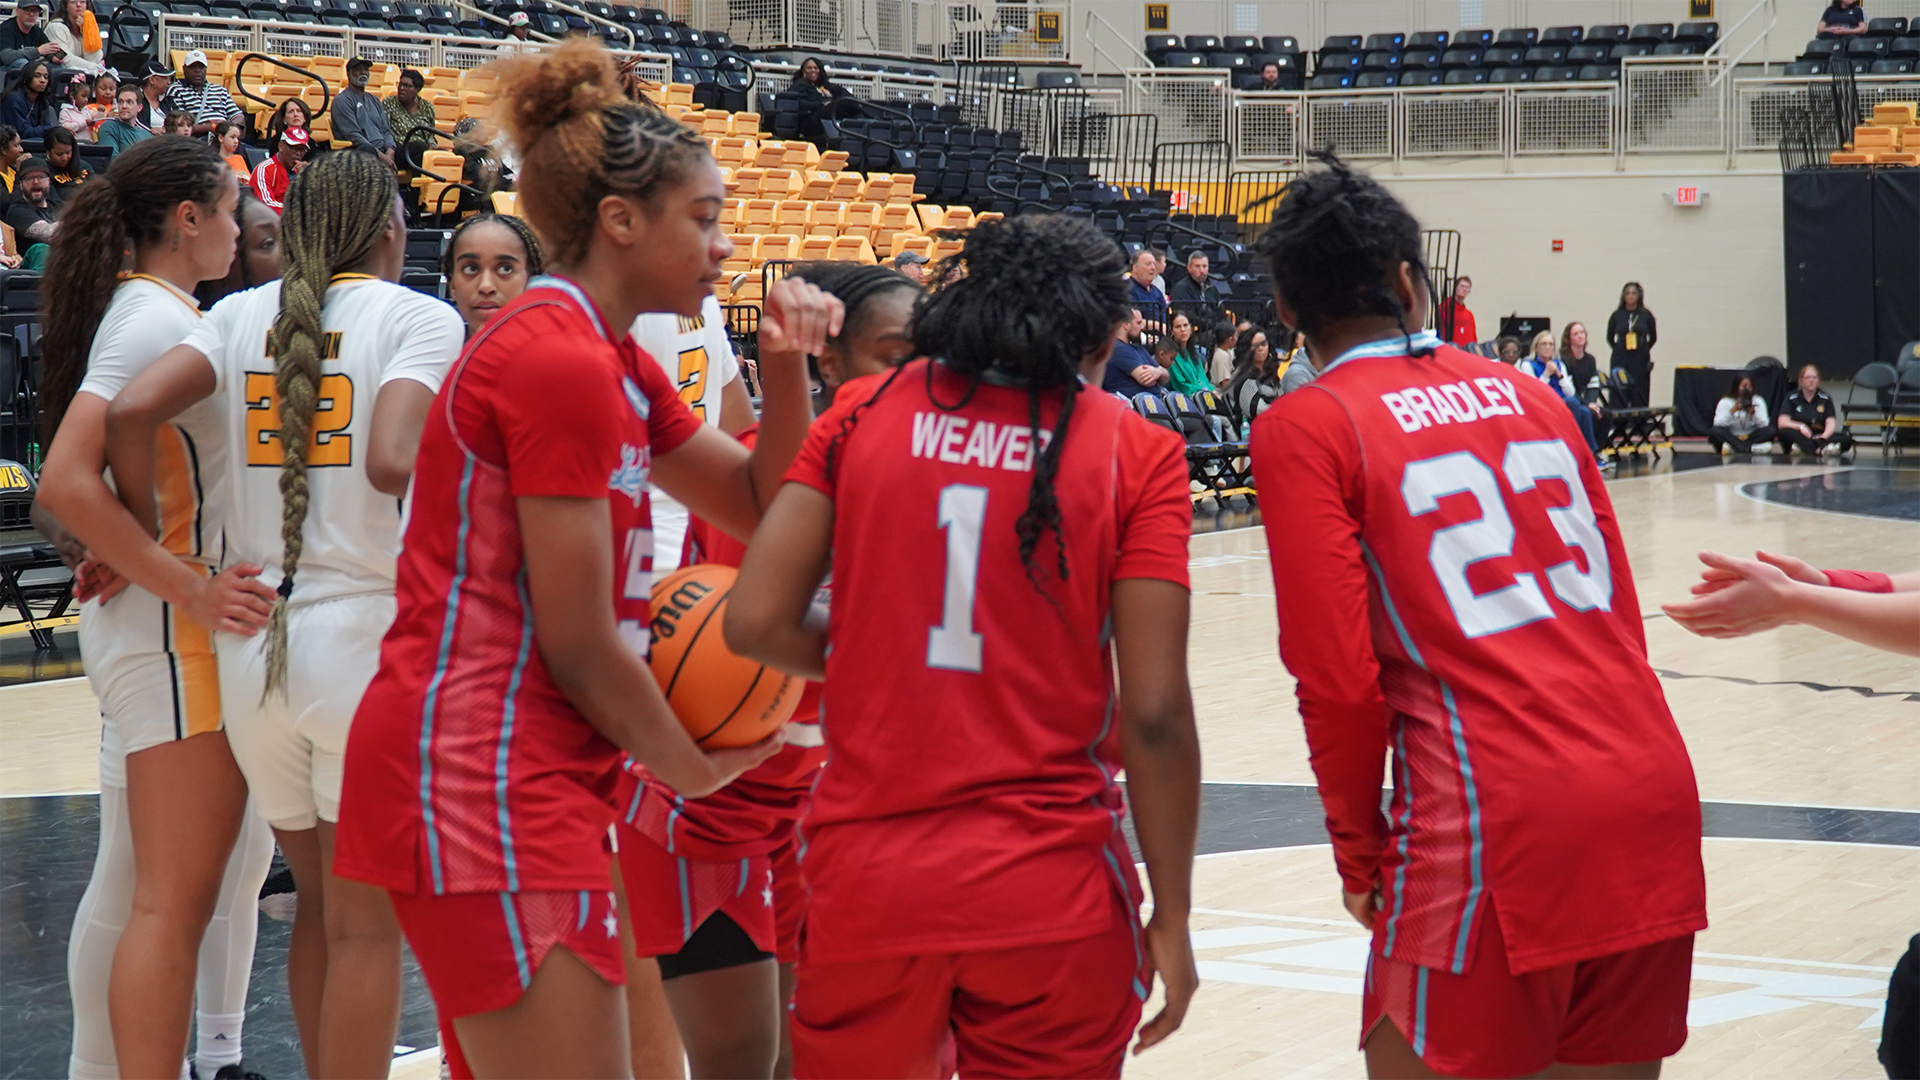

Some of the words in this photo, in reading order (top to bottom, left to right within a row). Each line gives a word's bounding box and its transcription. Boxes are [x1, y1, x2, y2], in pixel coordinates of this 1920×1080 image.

[1042, 20, 1057, 29] 112
[1152, 10, 1164, 19] 111
[1677, 187, 1697, 203] EXIT
[245, 371, 354, 468] 22
[1380, 381, 1525, 433] BRADLEY
[1400, 438, 1614, 639] 23
[926, 482, 989, 674] 1
